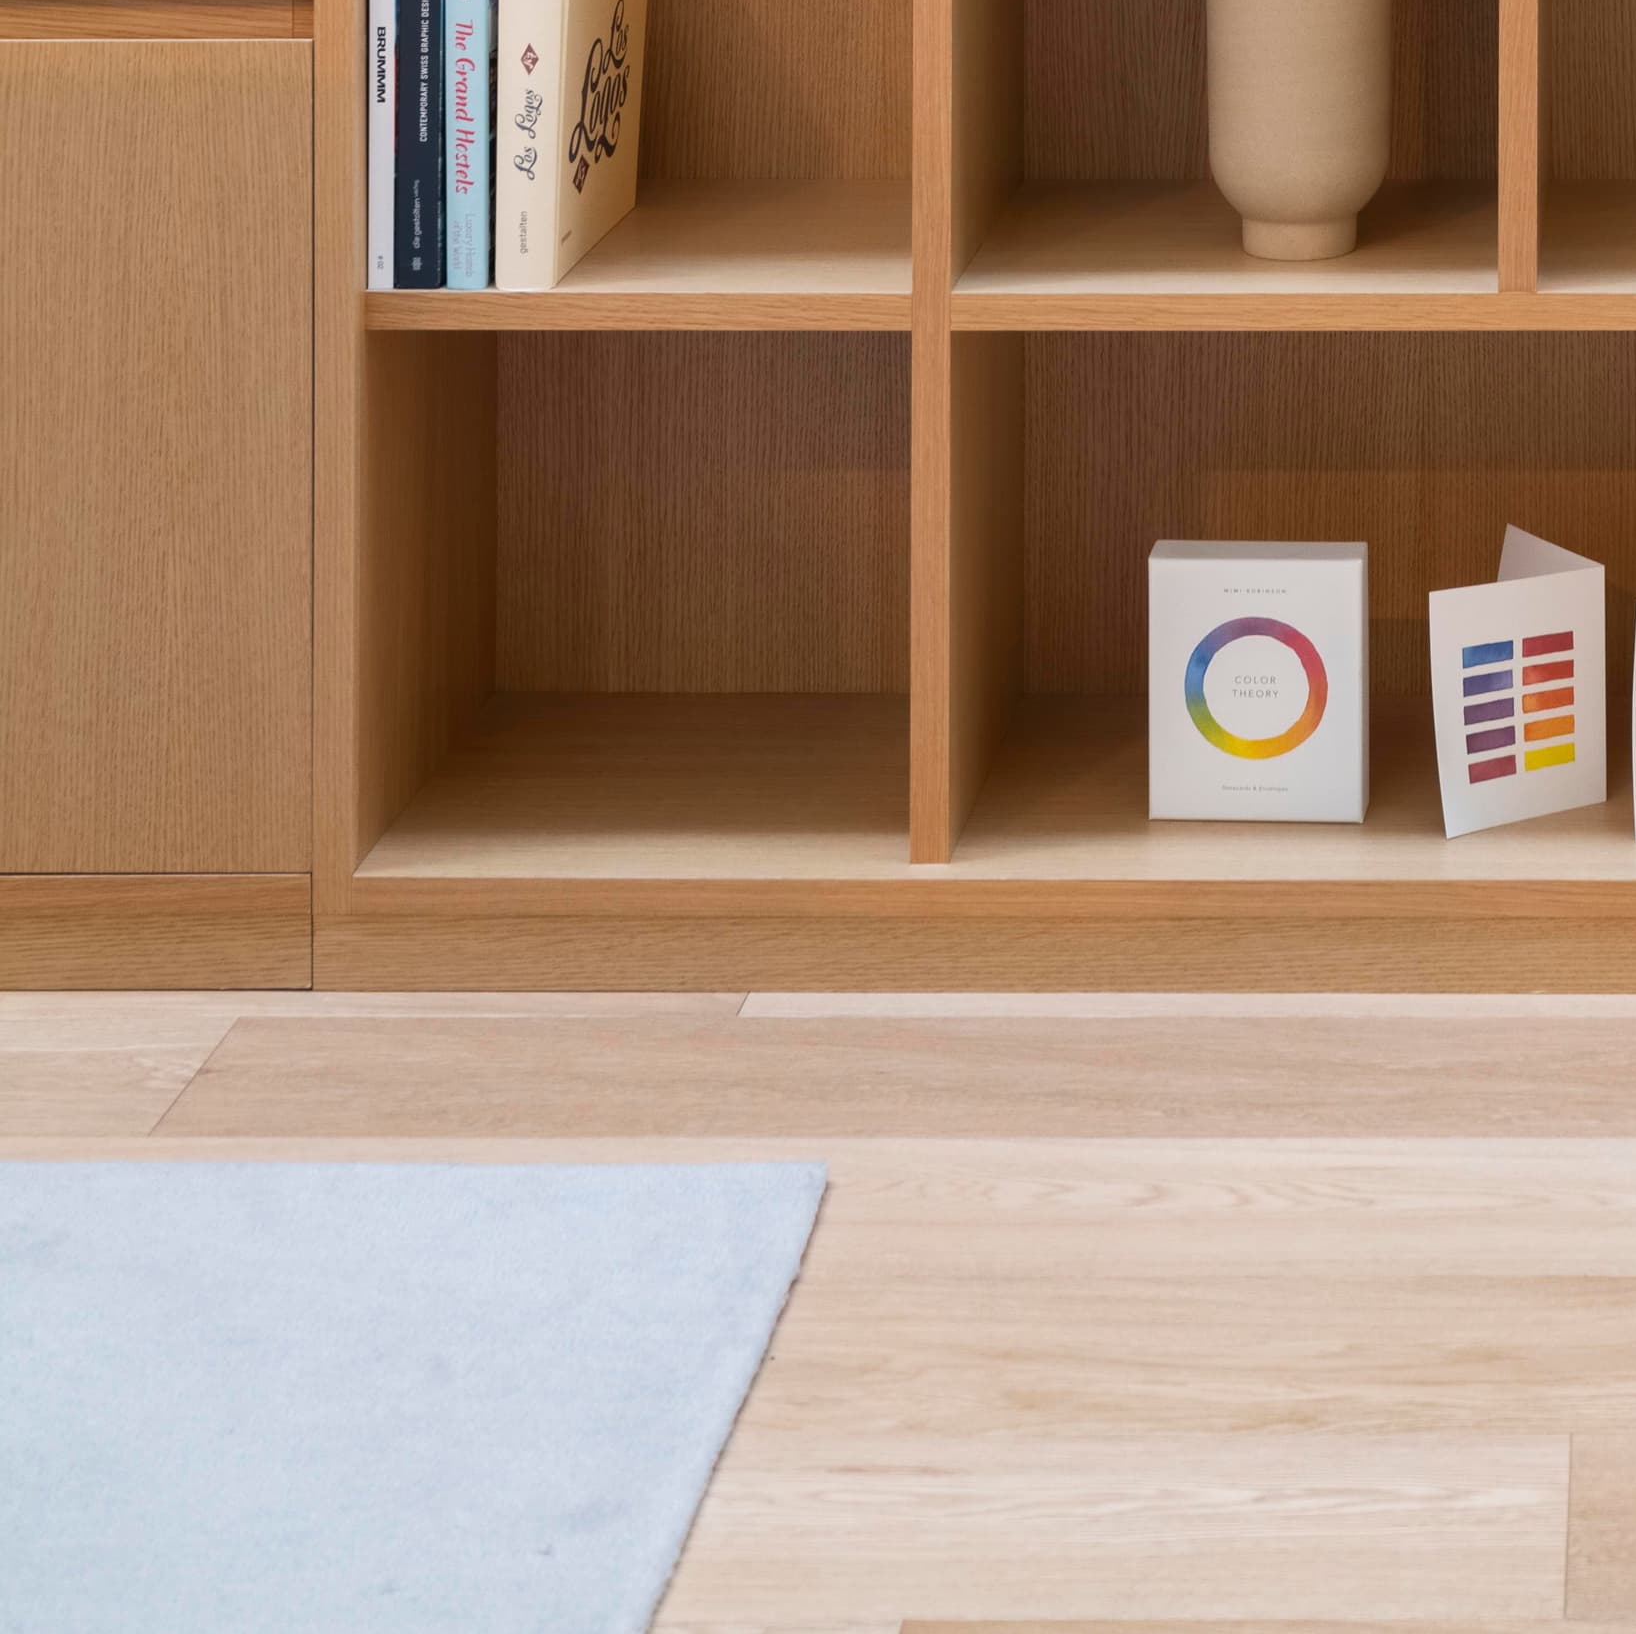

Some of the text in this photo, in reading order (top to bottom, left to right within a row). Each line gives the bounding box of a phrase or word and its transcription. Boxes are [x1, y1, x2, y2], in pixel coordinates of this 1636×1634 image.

[420, 20, 430, 52] GRAPHIC
[377, 27, 386, 103] BRUMMM
[420, 56, 429, 79] SWISS
[419, 82, 429, 142] CONTEMPORARY
[455, 20, 475, 194] The Grand Hostels
[513, 89, 542, 180] Los Logos
[1232, 690, 1278, 699] THEORY
[1234, 676, 1277, 684] COLOR
